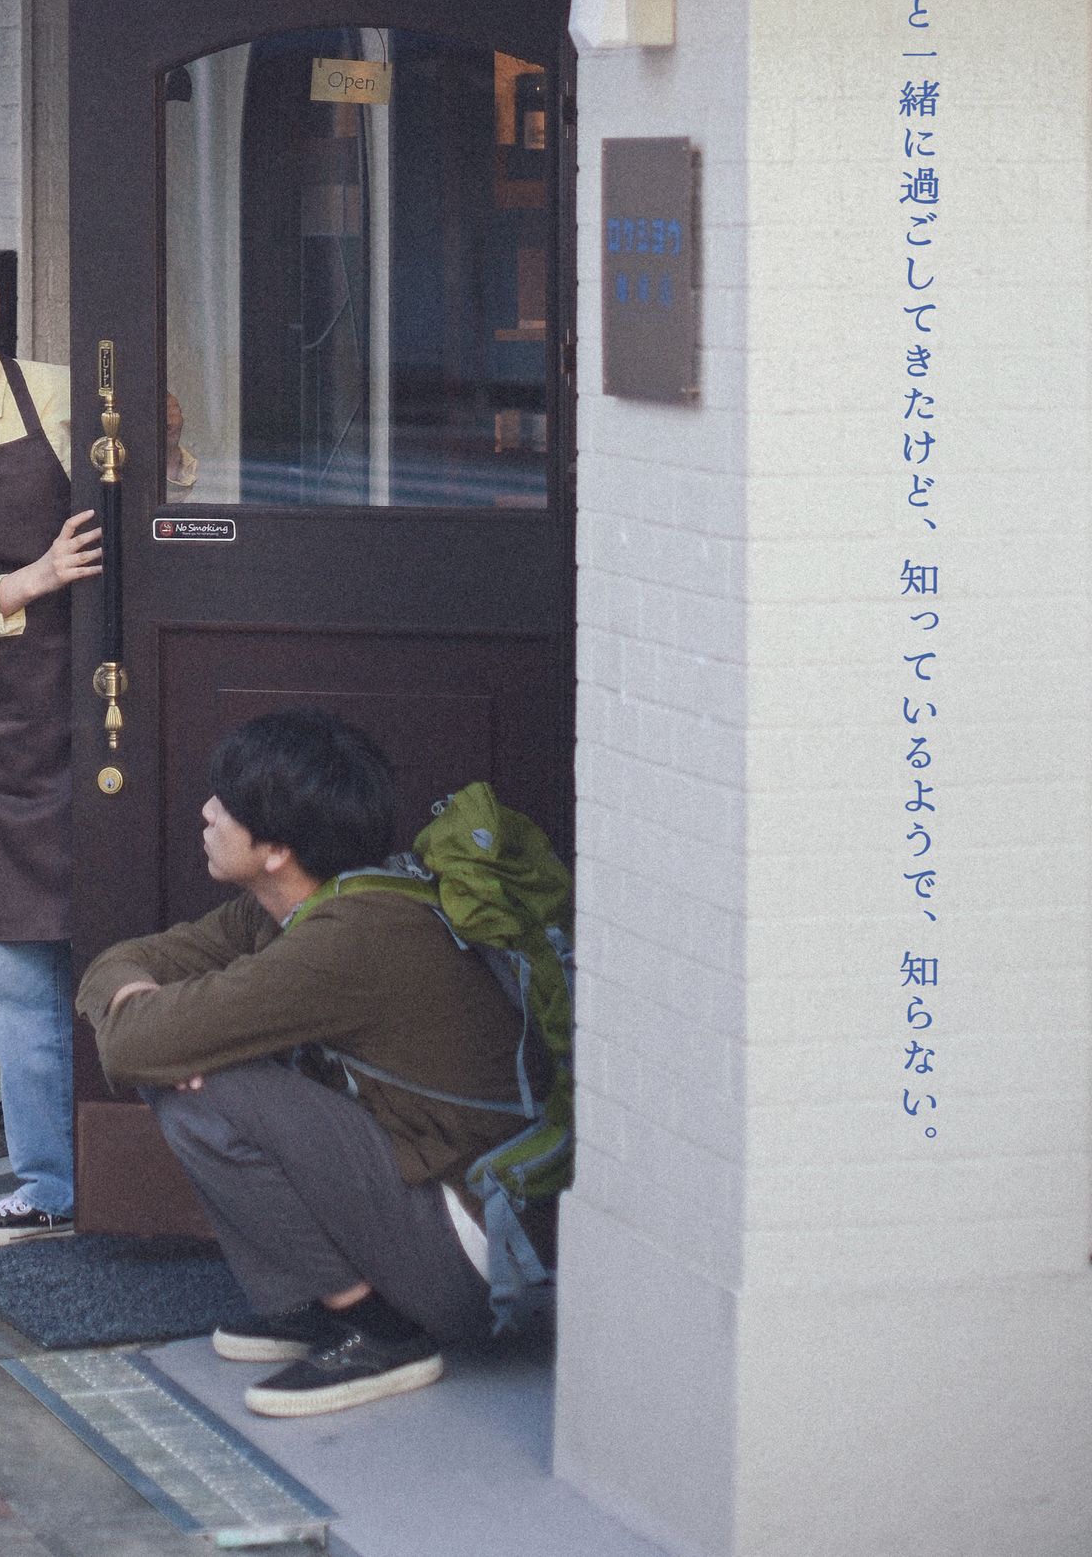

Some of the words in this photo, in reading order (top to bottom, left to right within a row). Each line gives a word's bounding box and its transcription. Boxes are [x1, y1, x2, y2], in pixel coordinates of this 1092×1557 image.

[328, 71, 375, 95] Open
[175, 523, 187, 532] No
[188, 523, 229, 534] Smoking
